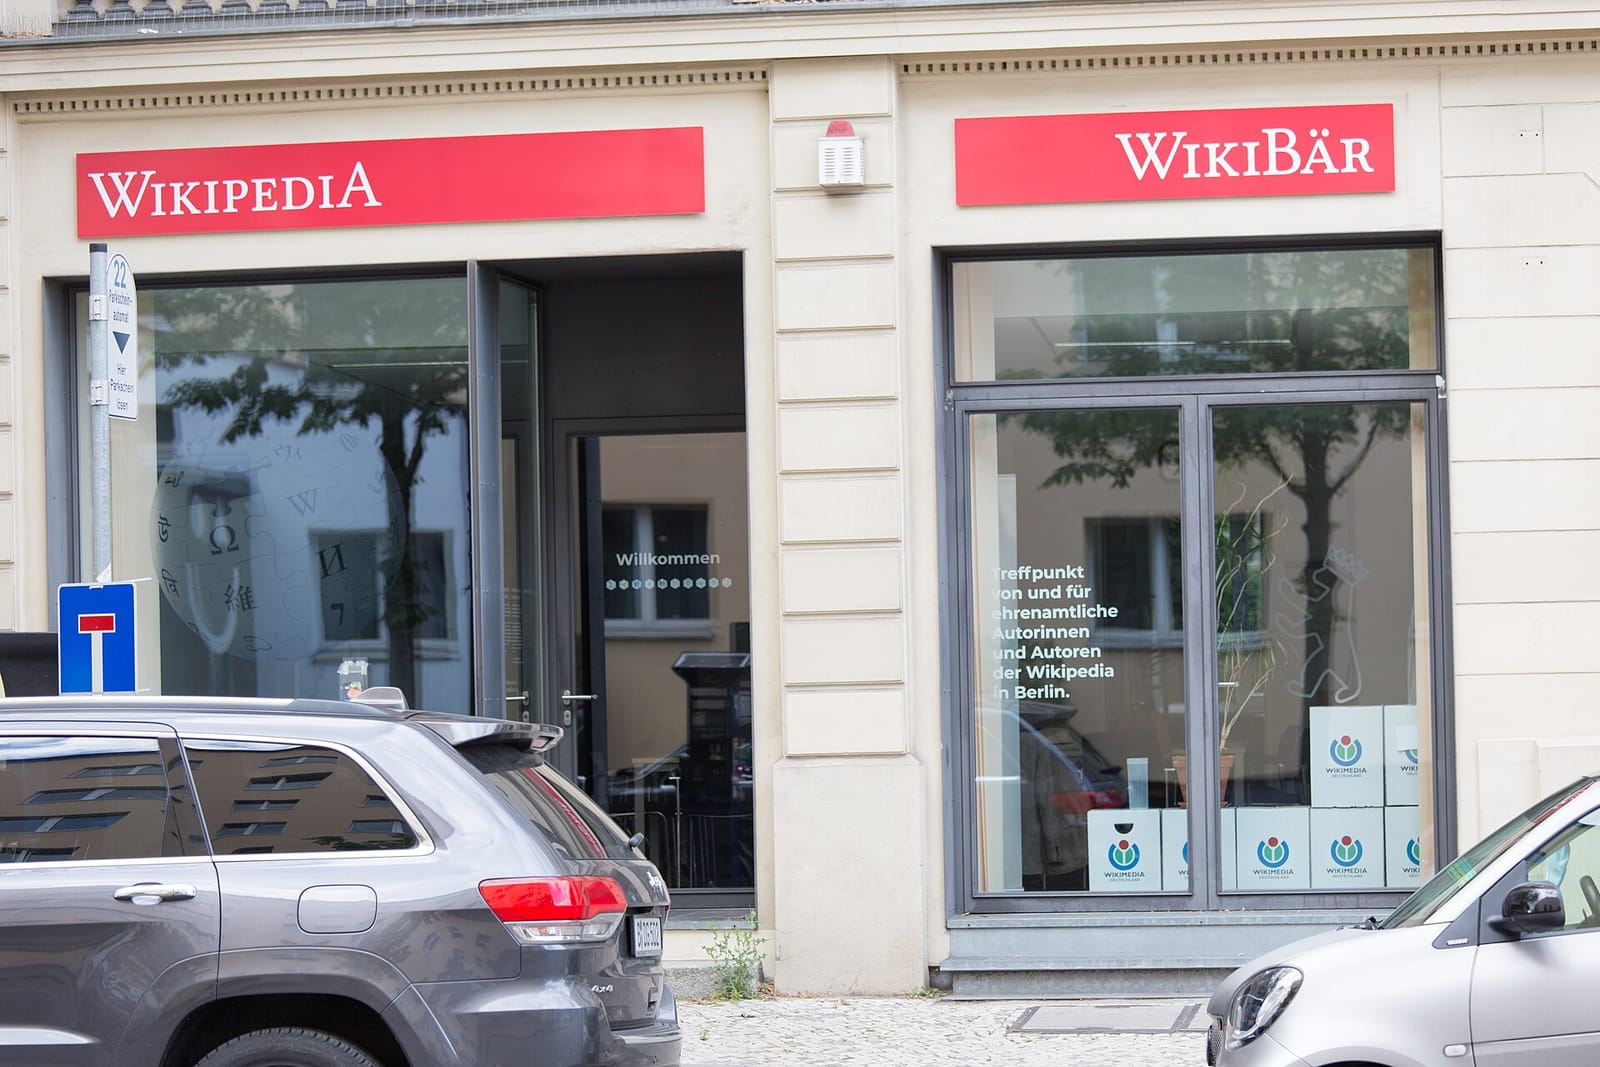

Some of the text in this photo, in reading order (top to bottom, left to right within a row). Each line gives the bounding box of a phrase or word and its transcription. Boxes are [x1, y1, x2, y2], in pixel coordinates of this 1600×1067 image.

[113, 259, 127, 289] 22
[285, 487, 319, 517] W
[209, 524, 239, 556] Ω
[616, 552, 720, 567] Willkommen
[991, 565, 1085, 583] Treffpunkt
[991, 585, 1092, 600] von und für
[992, 604, 1119, 620] ehrenamtliche
[992, 625, 1090, 640] Autorinnen
[993, 646, 1101, 660] und Autoren
[993, 664, 1115, 681] der Wikipedia
[994, 684, 1070, 699] in Berlin.
[591, 984, 614, 993] 4x4
